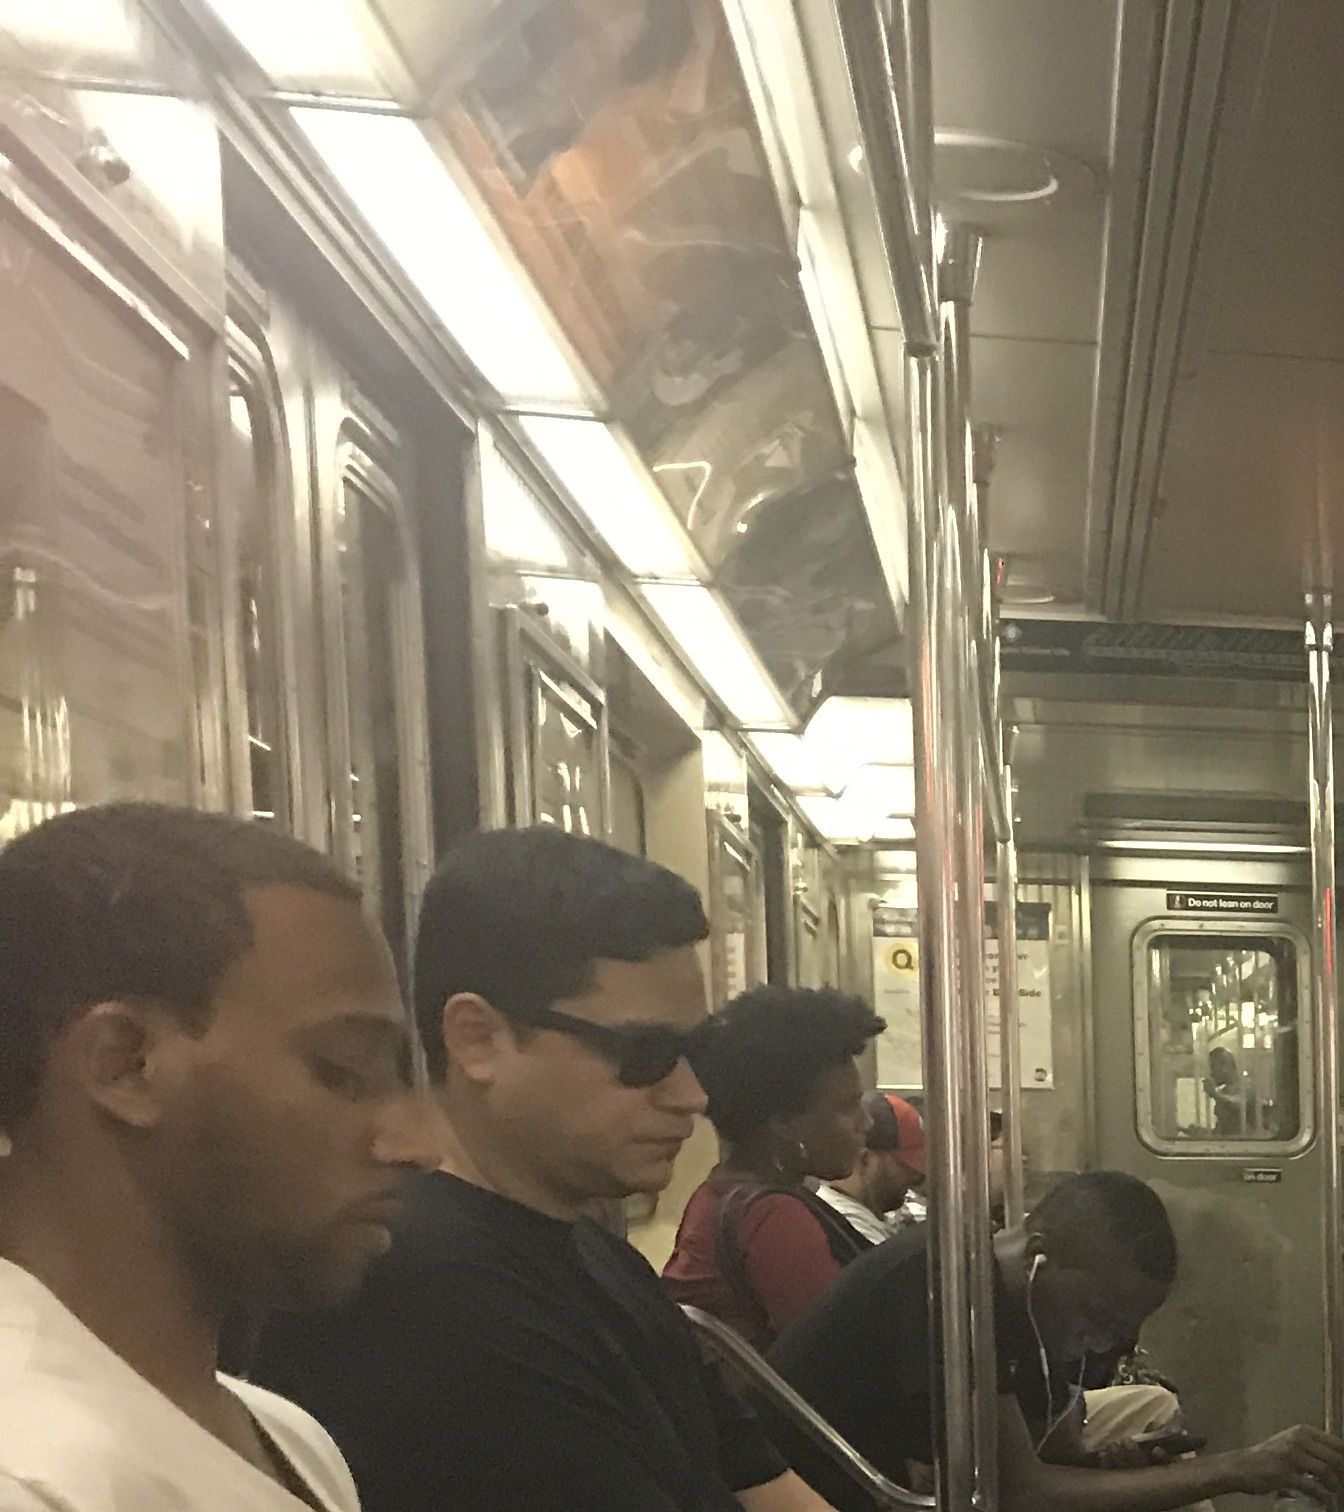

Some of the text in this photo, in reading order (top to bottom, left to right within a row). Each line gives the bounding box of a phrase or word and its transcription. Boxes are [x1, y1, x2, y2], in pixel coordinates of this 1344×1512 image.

[1188, 897, 1201, 908] Do
[1202, 898, 1218, 908] not
[1218, 898, 1240, 909] lean
[1252, 899, 1275, 910] door
[891, 949, 914, 970] Q
